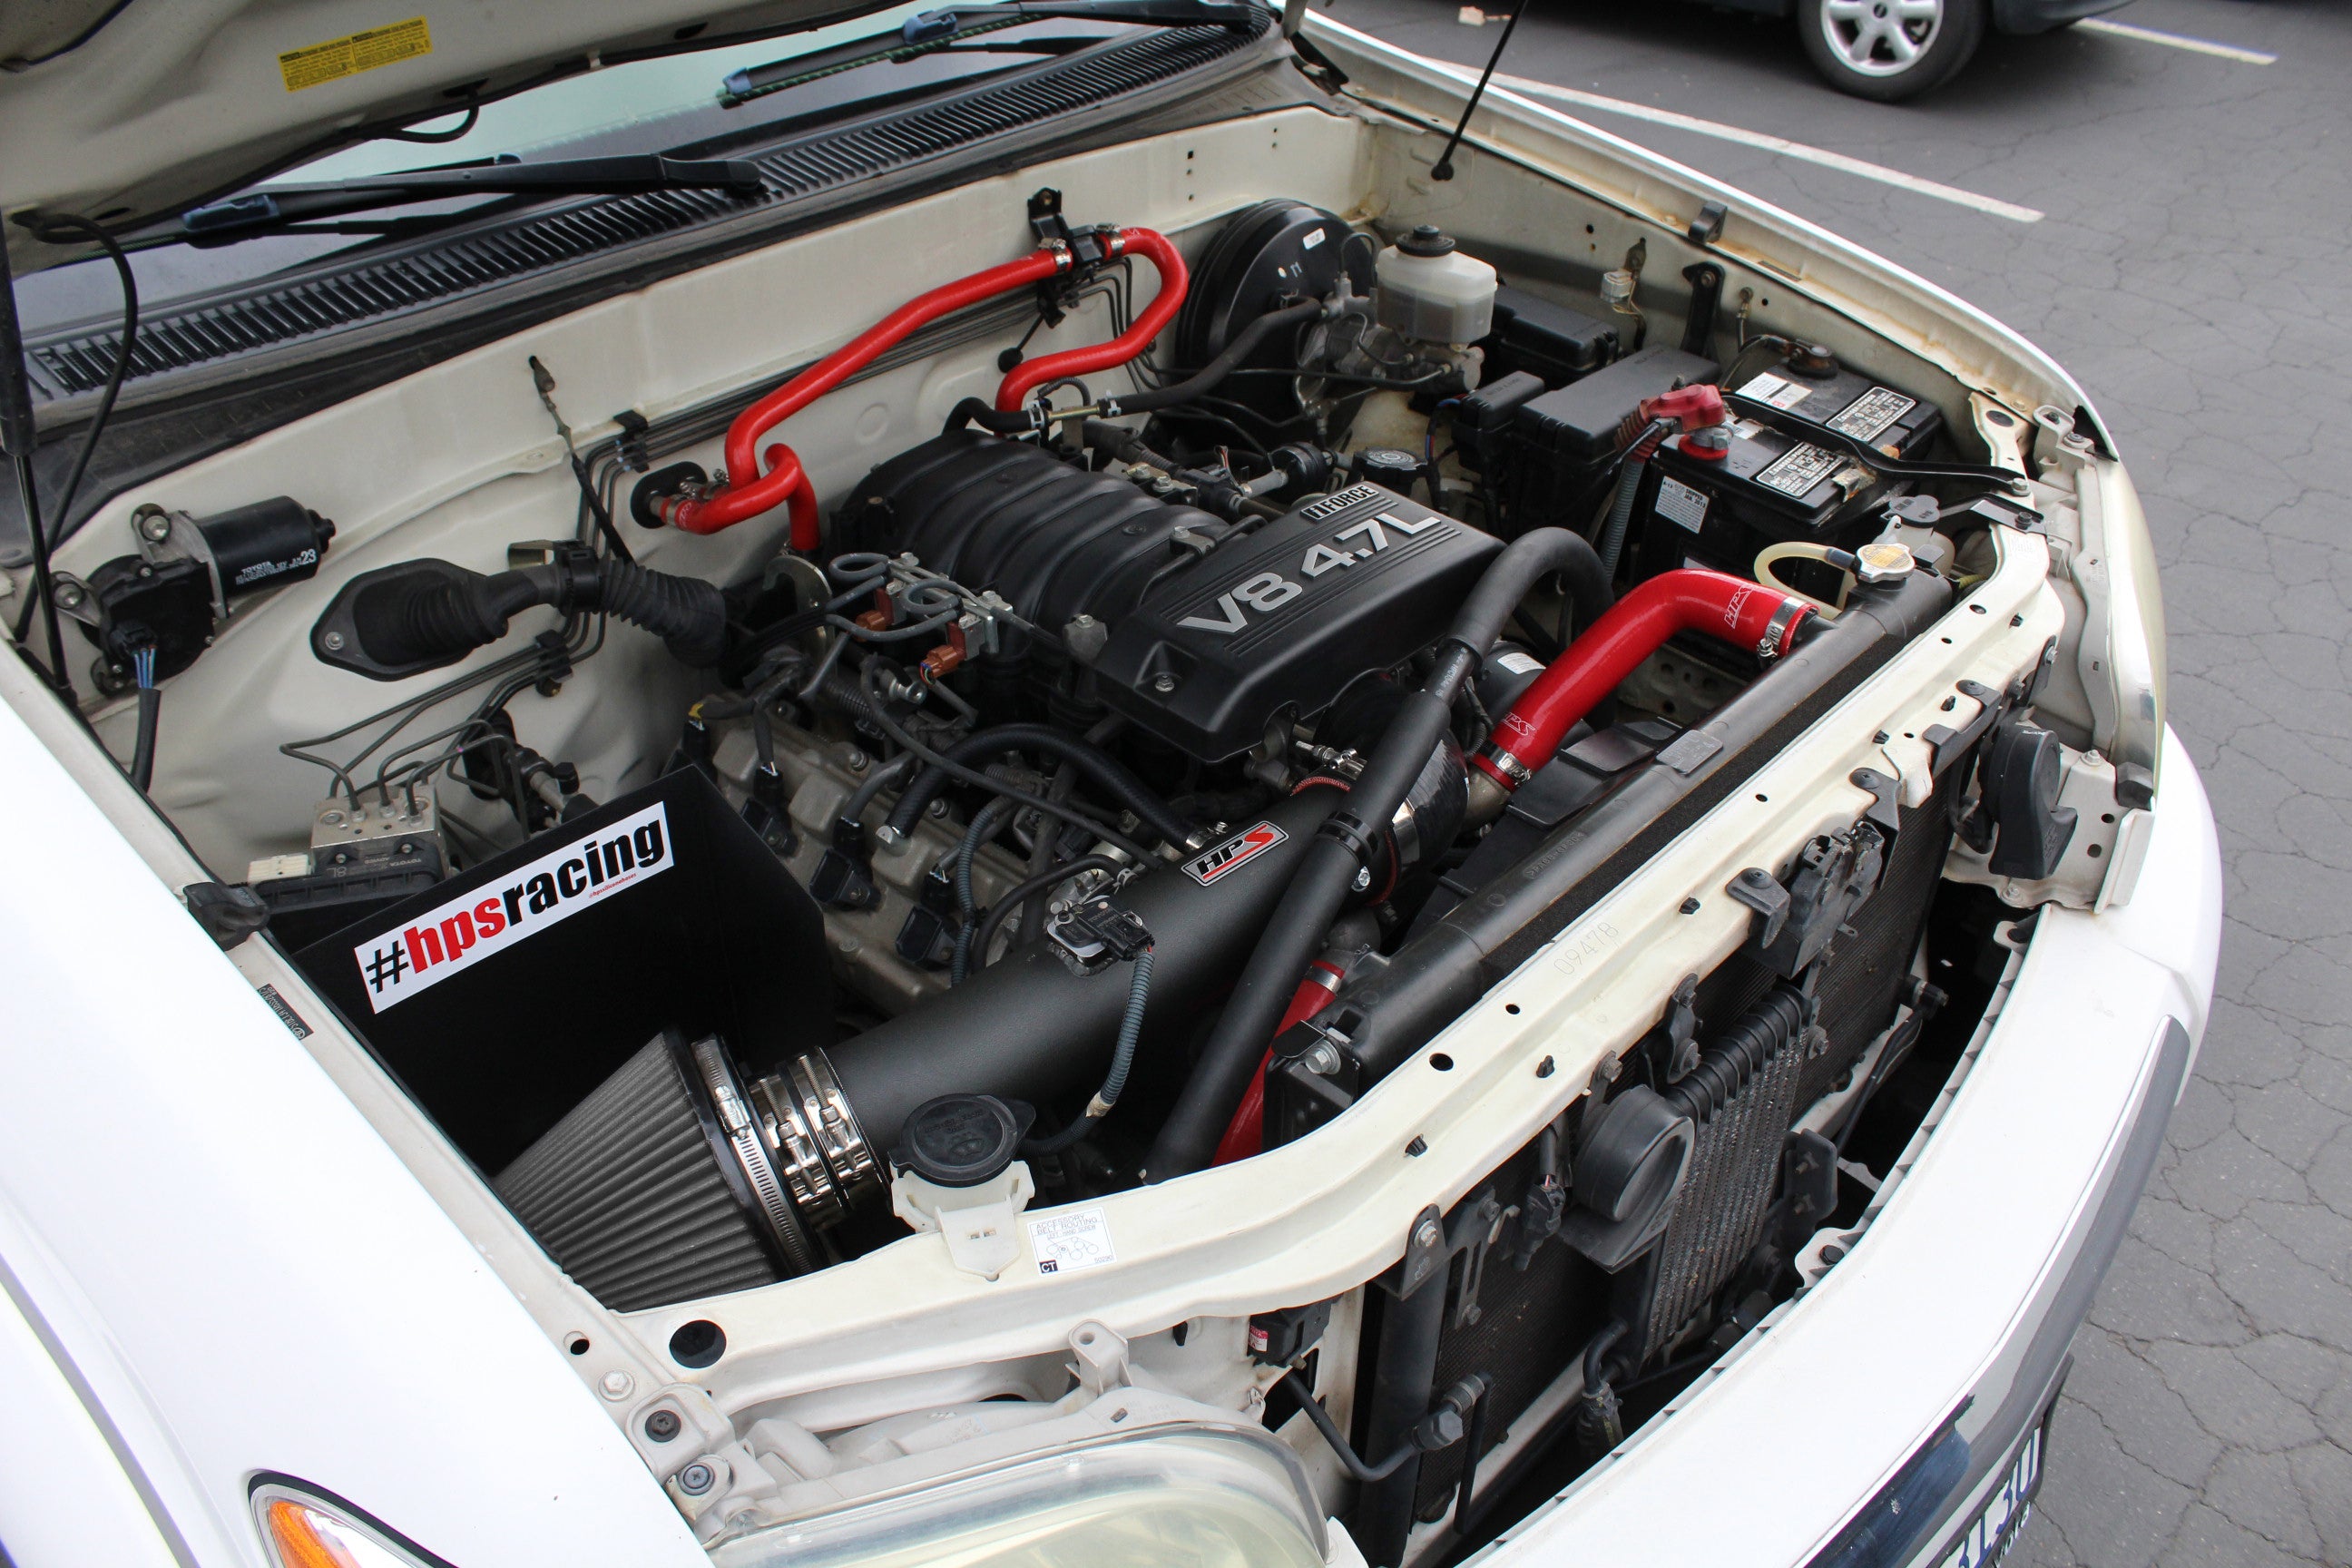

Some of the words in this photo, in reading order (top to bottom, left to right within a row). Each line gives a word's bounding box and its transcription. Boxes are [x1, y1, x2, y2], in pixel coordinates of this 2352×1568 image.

[300, 548, 317, 564] 23
[240, 561, 272, 574] TOYOTA
[1177, 572, 1303, 633] V8
[1300, 513, 1441, 578] 4.7L
[1196, 824, 1275, 879] HPS
[366, 818, 665, 994] #hpsracing
[1553, 922, 1619, 975] 09478
[1036, 1214, 1085, 1230] ACCESSORY
[1061, 1217, 1098, 1230] ROUTING
[1041, 1261, 1057, 1273] CT
